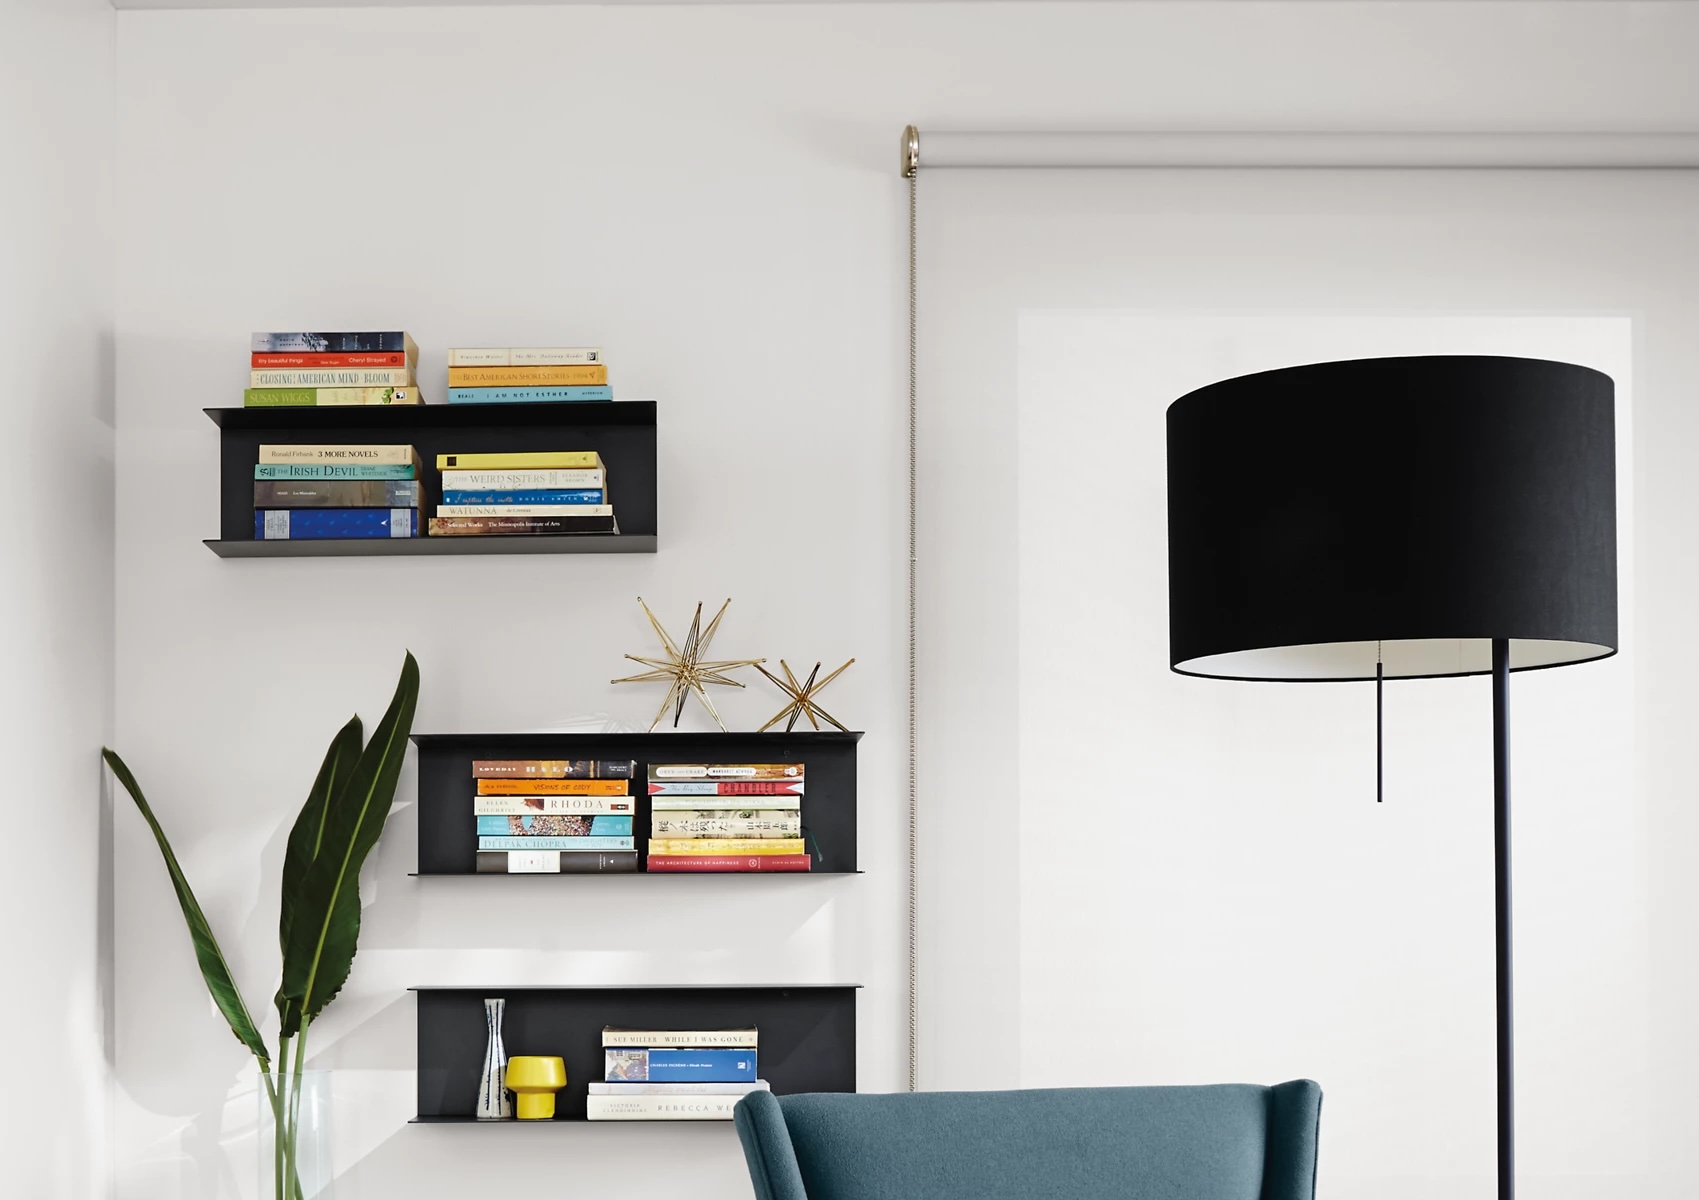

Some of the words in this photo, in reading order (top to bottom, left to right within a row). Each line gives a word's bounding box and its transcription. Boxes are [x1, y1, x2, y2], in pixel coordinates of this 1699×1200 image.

[260, 373, 293, 385] CLOSING
[297, 373, 335, 384] AMERICAN
[338, 373, 359, 384] MIND
[364, 373, 390, 384] BLOOM
[463, 373, 478, 381] BEST
[479, 373, 518, 381] AMERICAN
[250, 393, 278, 403] SUSAN
[281, 392, 310, 402] WIGGS
[348, 450, 378, 458] NOVELS
[289, 465, 319, 476] IRISH
[323, 465, 358, 476] DEVIL
[470, 474, 505, 483] WEIRD
[507, 474, 545, 483] SISTERS
[449, 507, 497, 515] WATUNNA
[723, 783, 777, 793] CHANDLER
[551, 800, 603, 808] RHODA
[484, 840, 523, 848] DEEPAK
[525, 840, 567, 848] CHOPRA
[657, 1104, 709, 1112] REBECCA
[716, 1104, 731, 1112] WE
